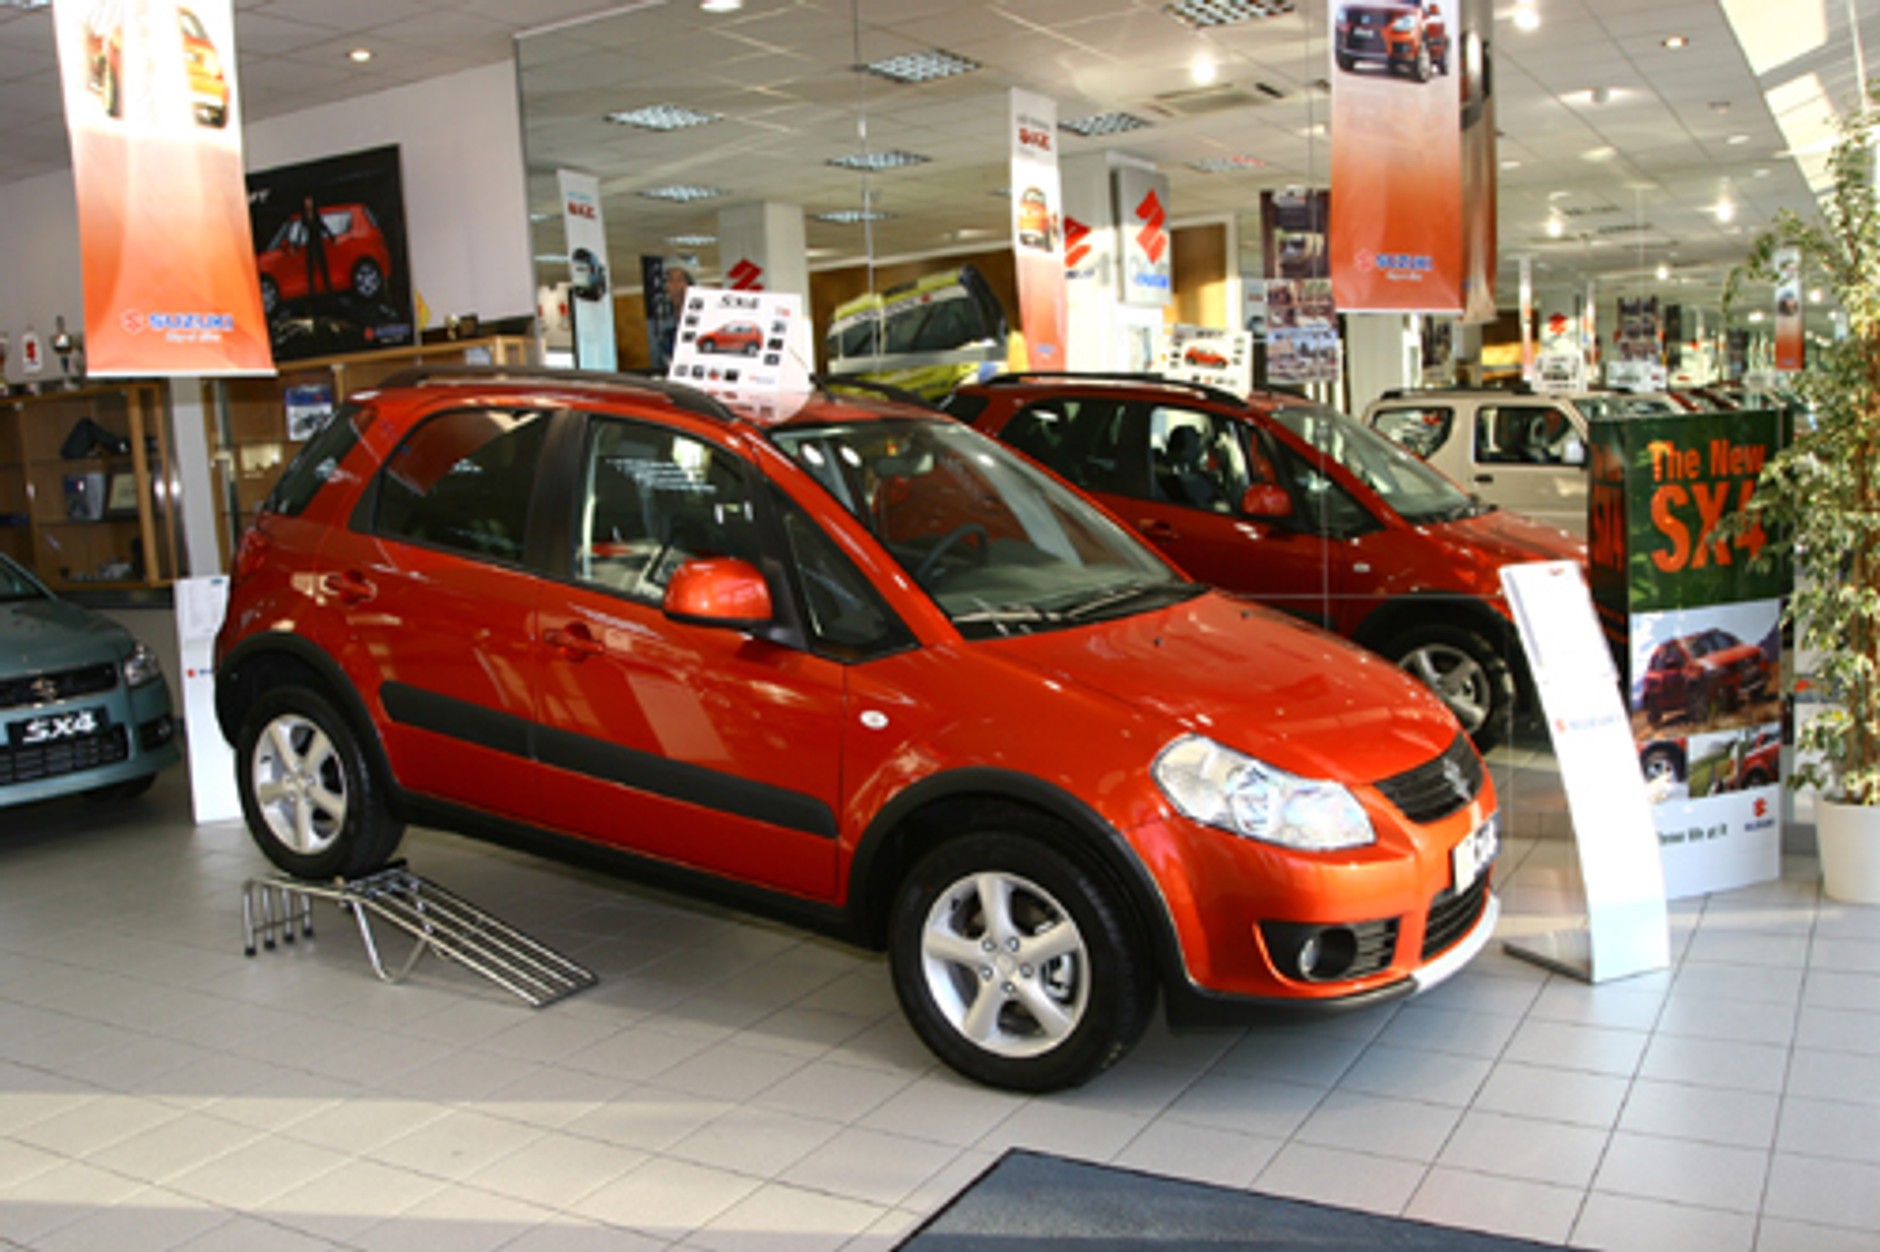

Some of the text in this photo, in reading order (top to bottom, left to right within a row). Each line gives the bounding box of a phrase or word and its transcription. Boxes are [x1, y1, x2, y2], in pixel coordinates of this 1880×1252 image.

[1375, 252, 1434, 272] SUZUKI
[148, 312, 234, 332] SUZUKI
[1647, 439, 1700, 482] The
[1710, 437, 1767, 477] New
[1651, 479, 1768, 574] SX4
[22, 713, 98, 743] SX4
